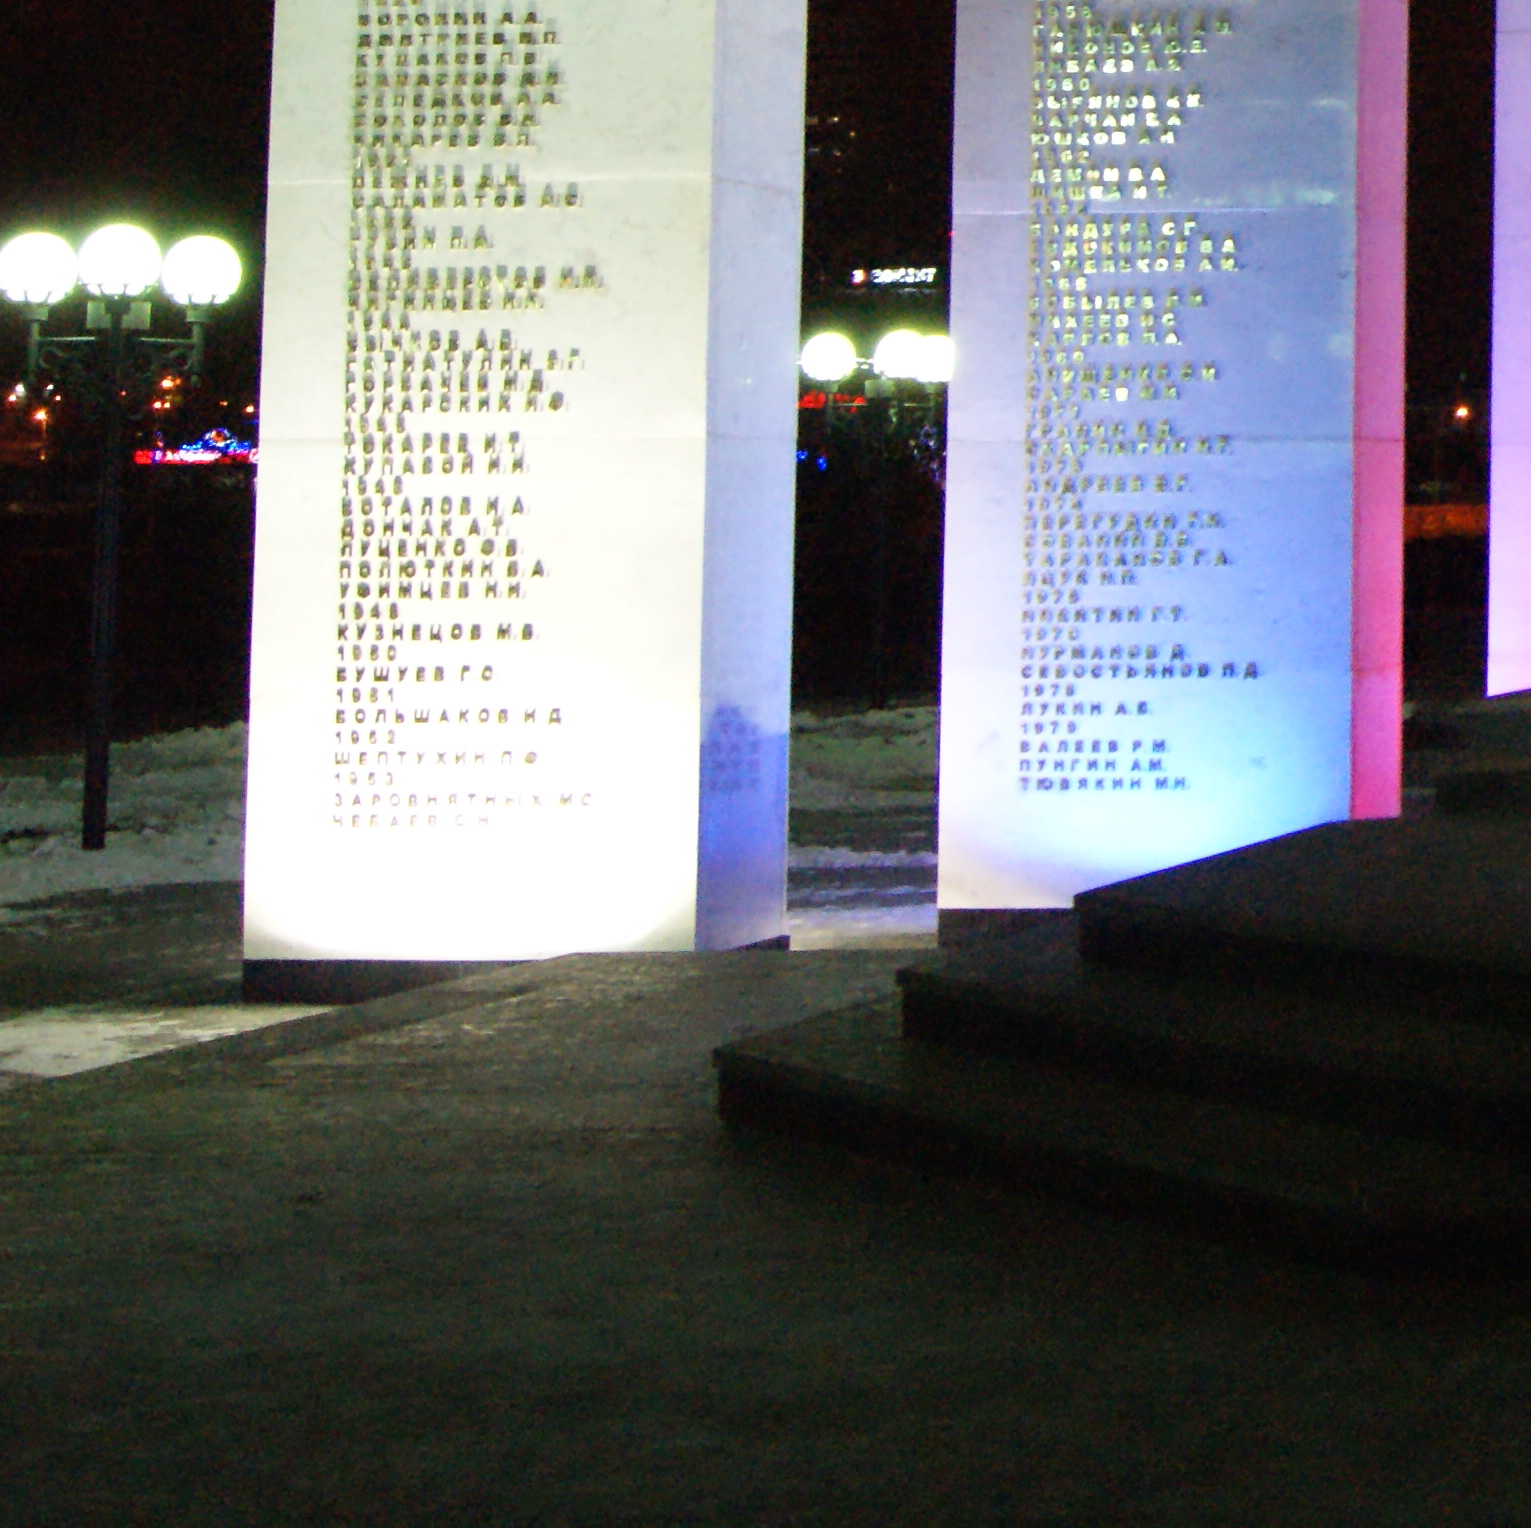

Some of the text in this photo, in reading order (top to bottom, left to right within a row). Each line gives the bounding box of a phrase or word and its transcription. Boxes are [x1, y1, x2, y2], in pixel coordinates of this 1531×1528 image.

[337, 623, 482, 642] КУЗНЕЦОВ
[336, 665, 445, 682] БУШУЕВ
[335, 708, 509, 723] БОЛЬШАКОВ
[334, 750, 485, 764] ШЕПТУХИН
[334, 793, 543, 806] ЗАРОВНЯТНЫХ
[333, 813, 437, 827] ЧЕБАЕВ
